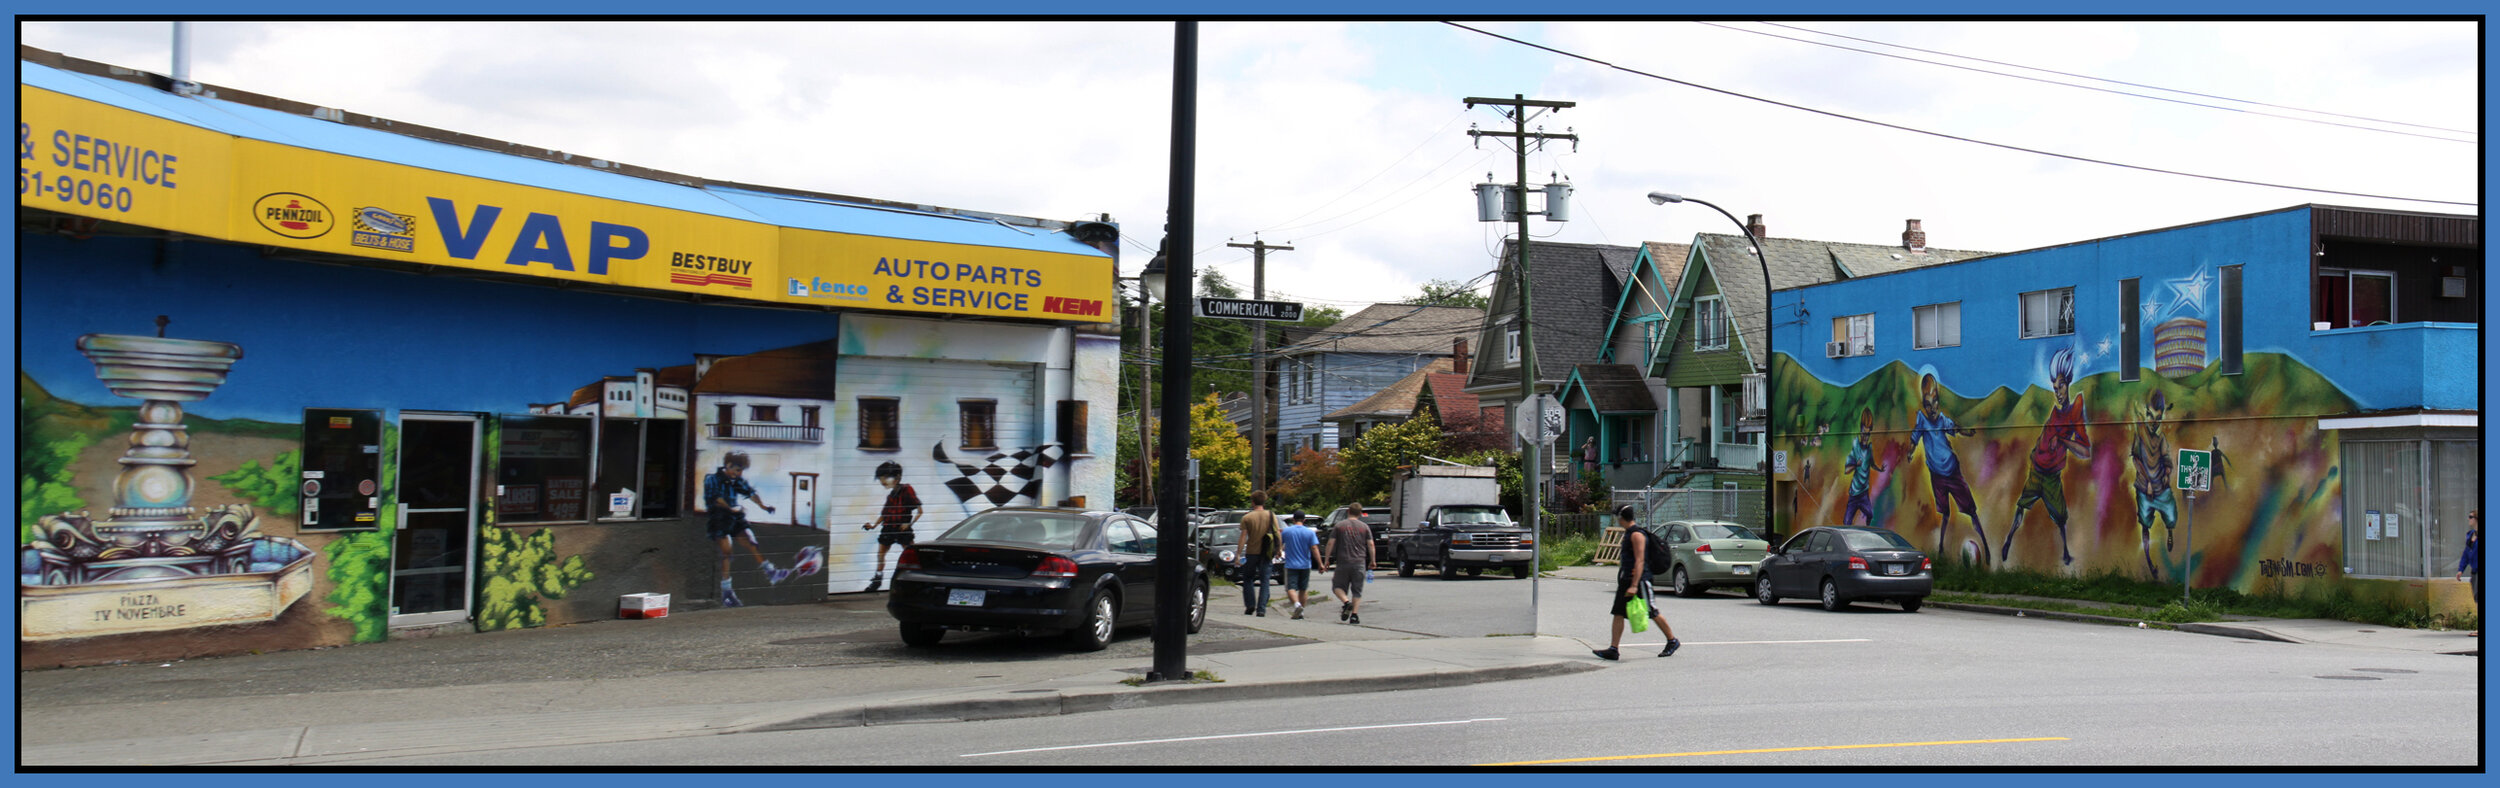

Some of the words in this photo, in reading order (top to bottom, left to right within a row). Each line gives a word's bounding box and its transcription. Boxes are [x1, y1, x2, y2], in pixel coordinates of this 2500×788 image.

[52, 129, 177, 189] SERVICE
[266, 207, 323, 223] PENNZOIL
[355, 233, 380, 246] BELTS
[380, 236, 387, 247] &
[388, 238, 411, 250] HOSE
[426, 196, 650, 275] VAP
[671, 252, 752, 275] BESTBUY
[873, 257, 950, 281] AUTO
[956, 264, 1042, 287] PARTS
[811, 276, 868, 296] fenco
[886, 285, 904, 304] &
[912, 287, 1029, 311] SERVICE
[1043, 296, 1103, 316] KEM
[1208, 301, 1276, 317] COMMERCIAL
[549, 489, 583, 500] SALE
[120, 593, 160, 607] PIAZZA
[95, 609, 112, 621] IV
[117, 604, 186, 620] NOVEMBRE
